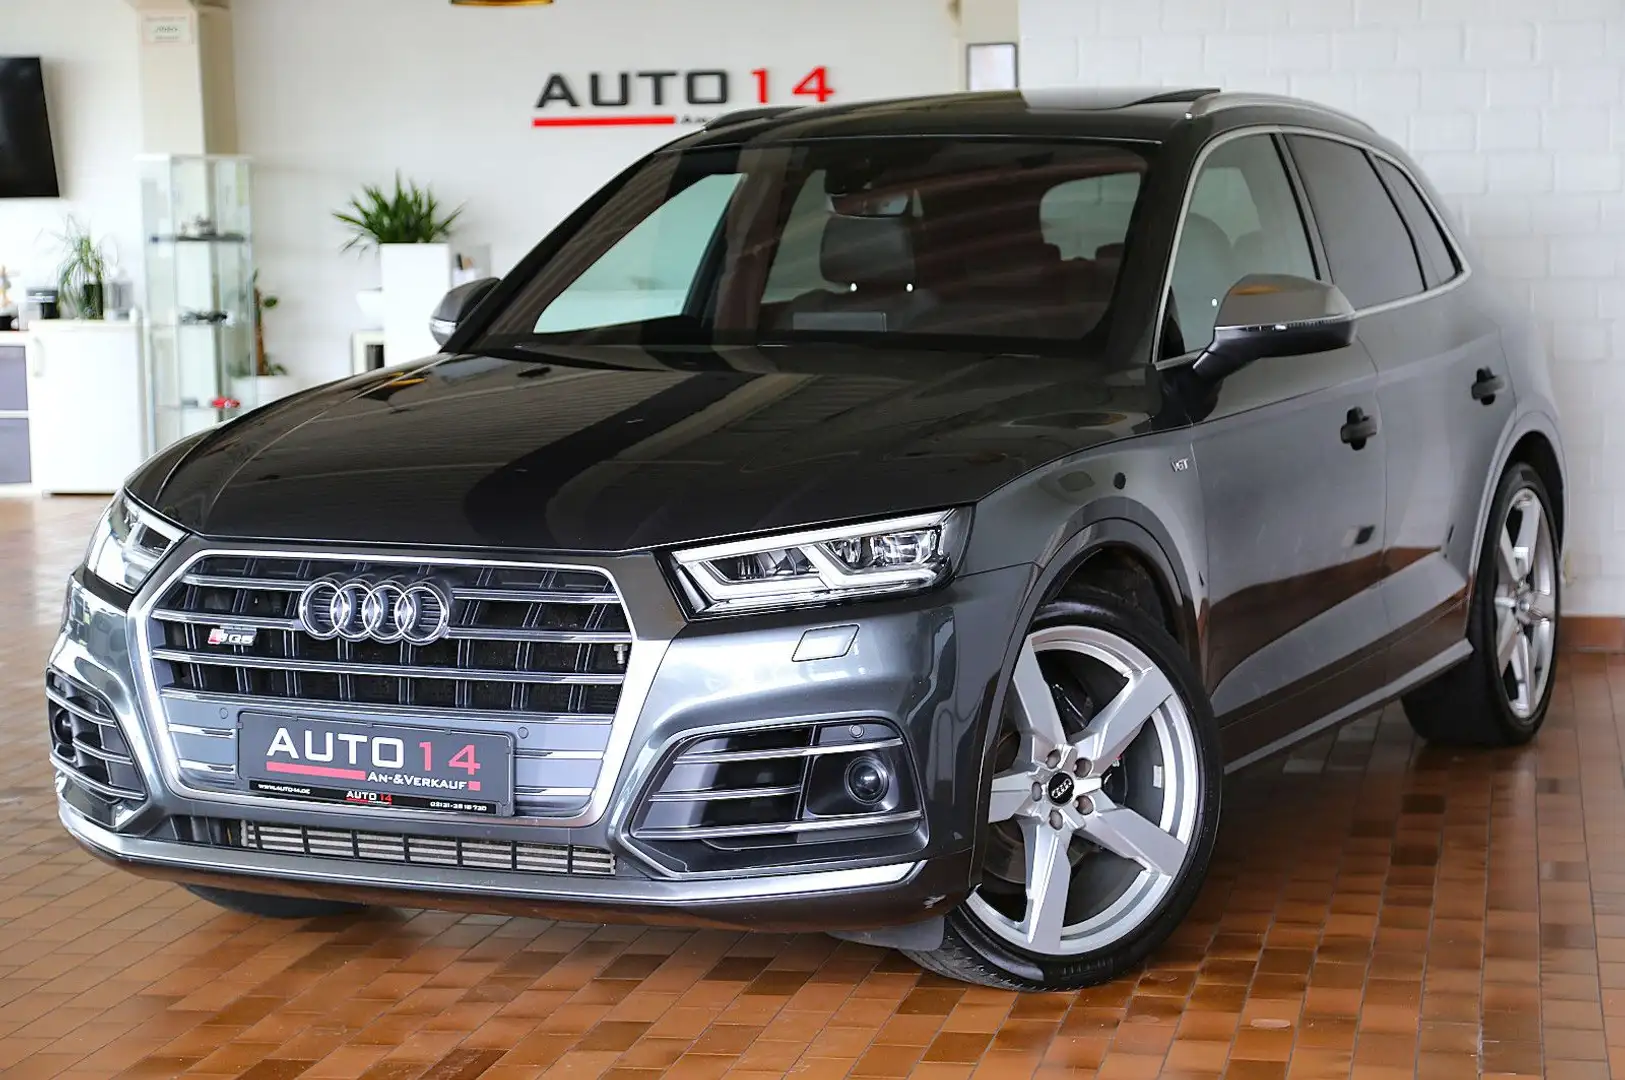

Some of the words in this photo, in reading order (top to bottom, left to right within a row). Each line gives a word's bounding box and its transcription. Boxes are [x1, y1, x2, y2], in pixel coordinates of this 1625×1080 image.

[535, 69, 728, 108] AUTO
[750, 65, 835, 104] 14
[266, 727, 404, 768] AUTO
[419, 741, 481, 775] 14
[346, 790, 377, 801] AUTO
[380, 793, 392, 803] 14
[367, 771, 467, 791] AN-&VERKAUF
